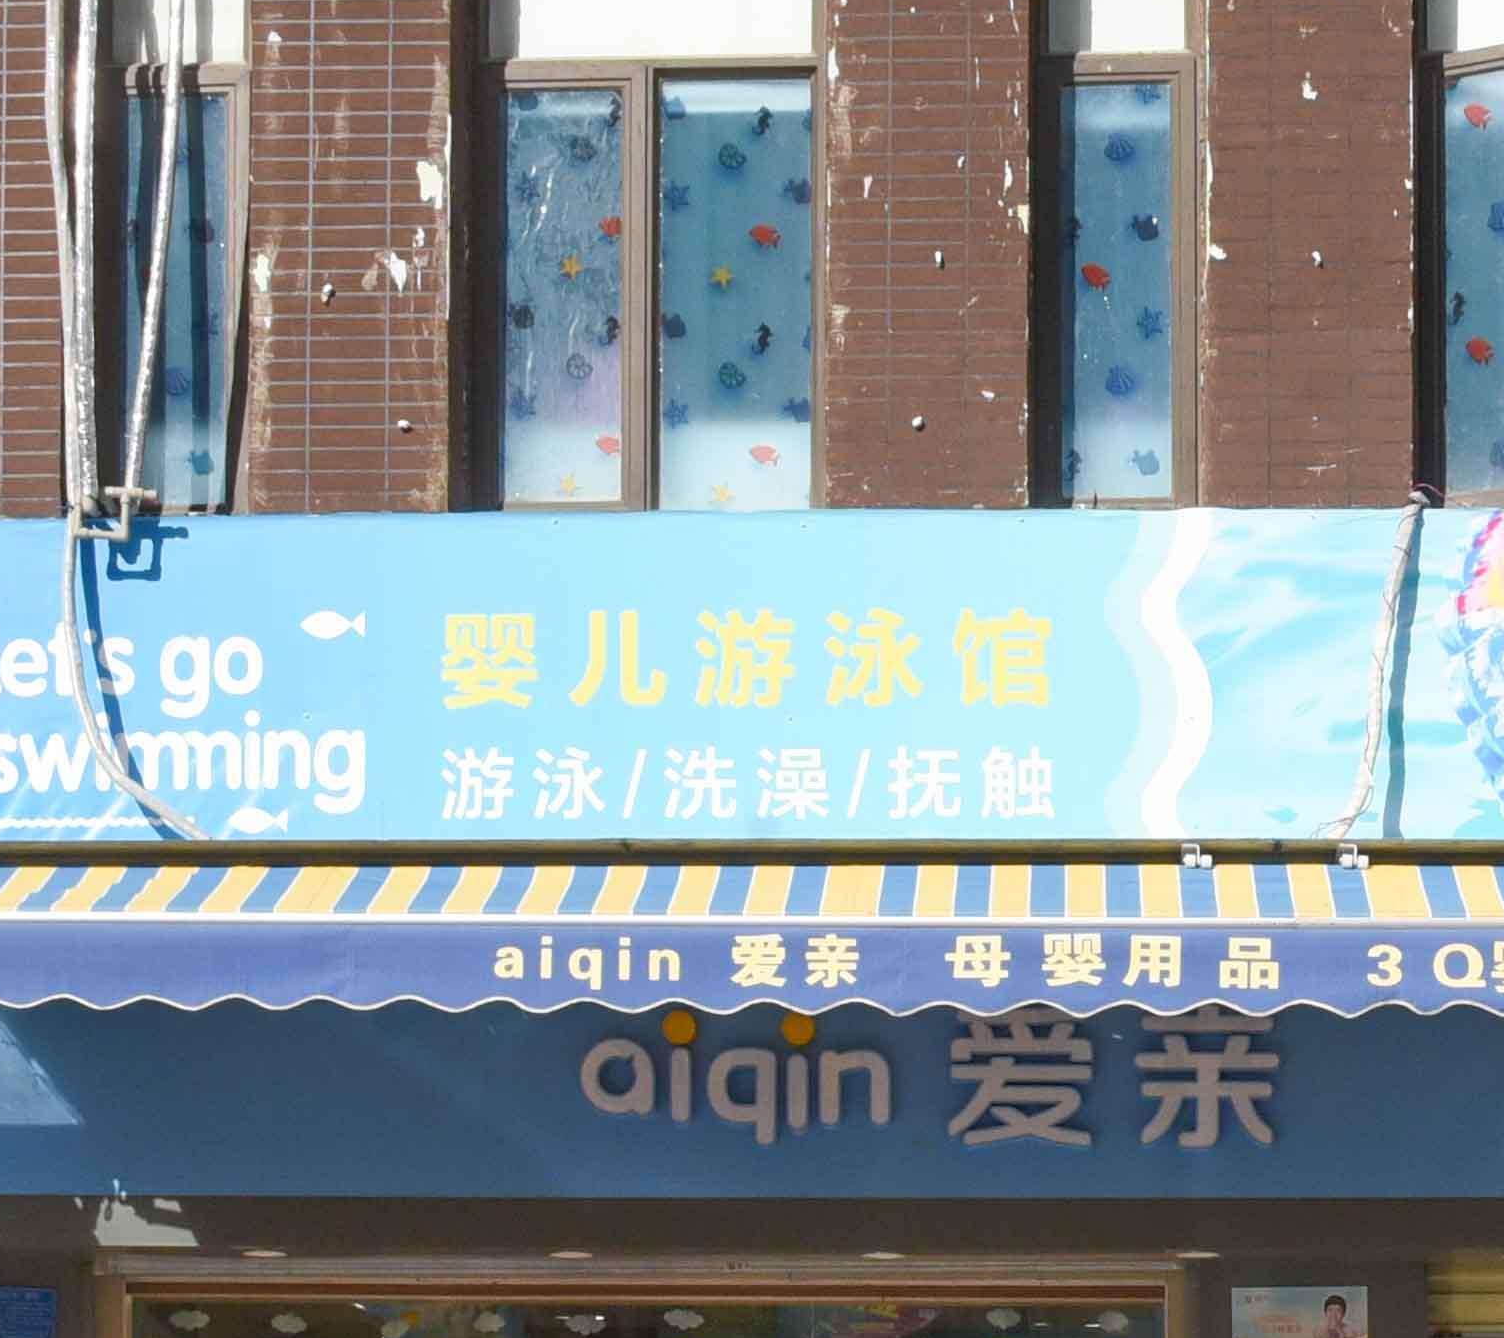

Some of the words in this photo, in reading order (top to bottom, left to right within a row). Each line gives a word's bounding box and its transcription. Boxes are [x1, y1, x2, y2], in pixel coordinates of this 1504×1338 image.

[159, 633, 265, 718] go
[442, 608, 1055, 709] 婴儿游泳馆
[442, 745, 1056, 822] 游泳/洗澡/抚触
[494, 937, 683, 985] aiqin
[729, 933, 862, 989] 爱亲
[944, 932, 1282, 991] 母婴用品
[580, 1011, 893, 1146] aiqin
[946, 1006, 1281, 1150] 爱亲
